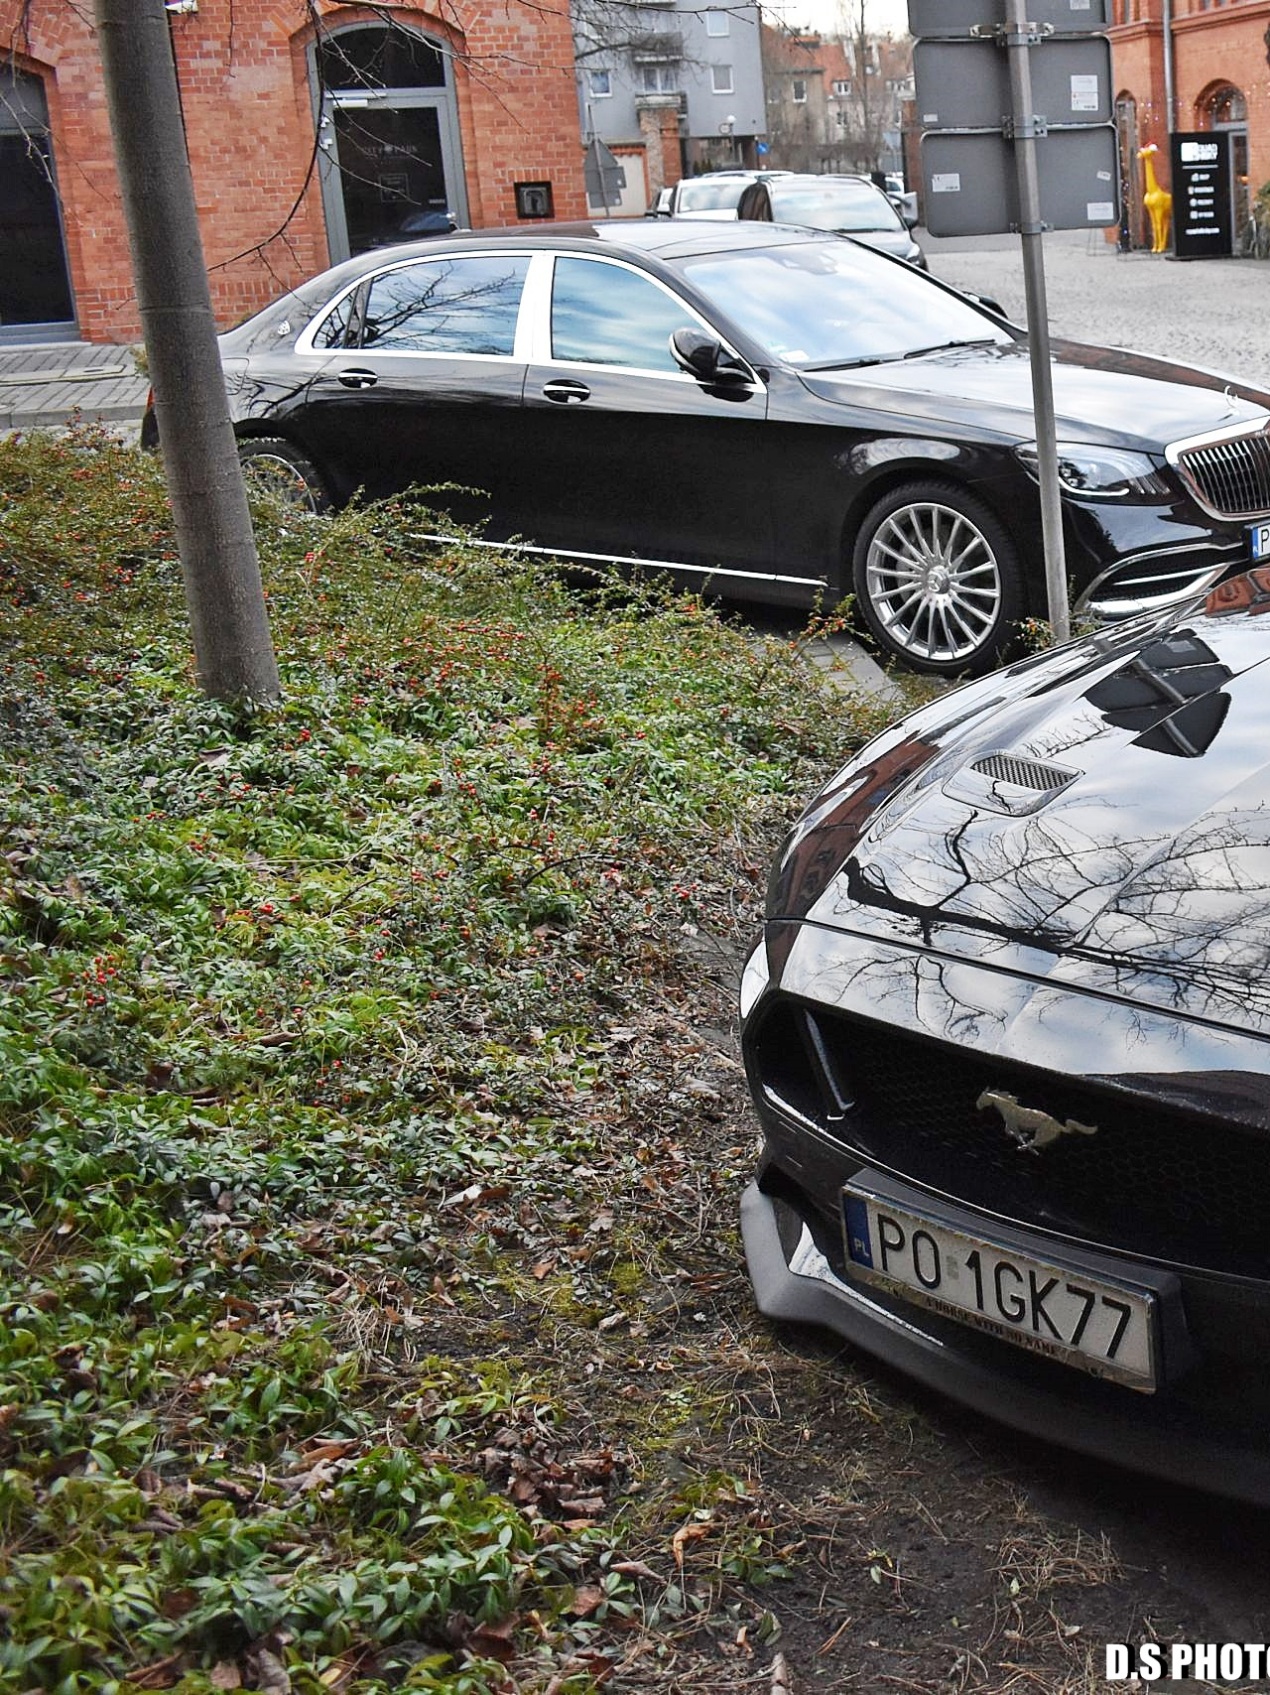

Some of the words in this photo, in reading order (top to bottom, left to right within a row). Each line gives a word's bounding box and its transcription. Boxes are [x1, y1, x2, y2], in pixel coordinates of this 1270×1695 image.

[853, 1237, 870, 1257] PL
[876, 1213, 942, 1289] PO
[964, 1250, 1132, 1359] 1GK77
